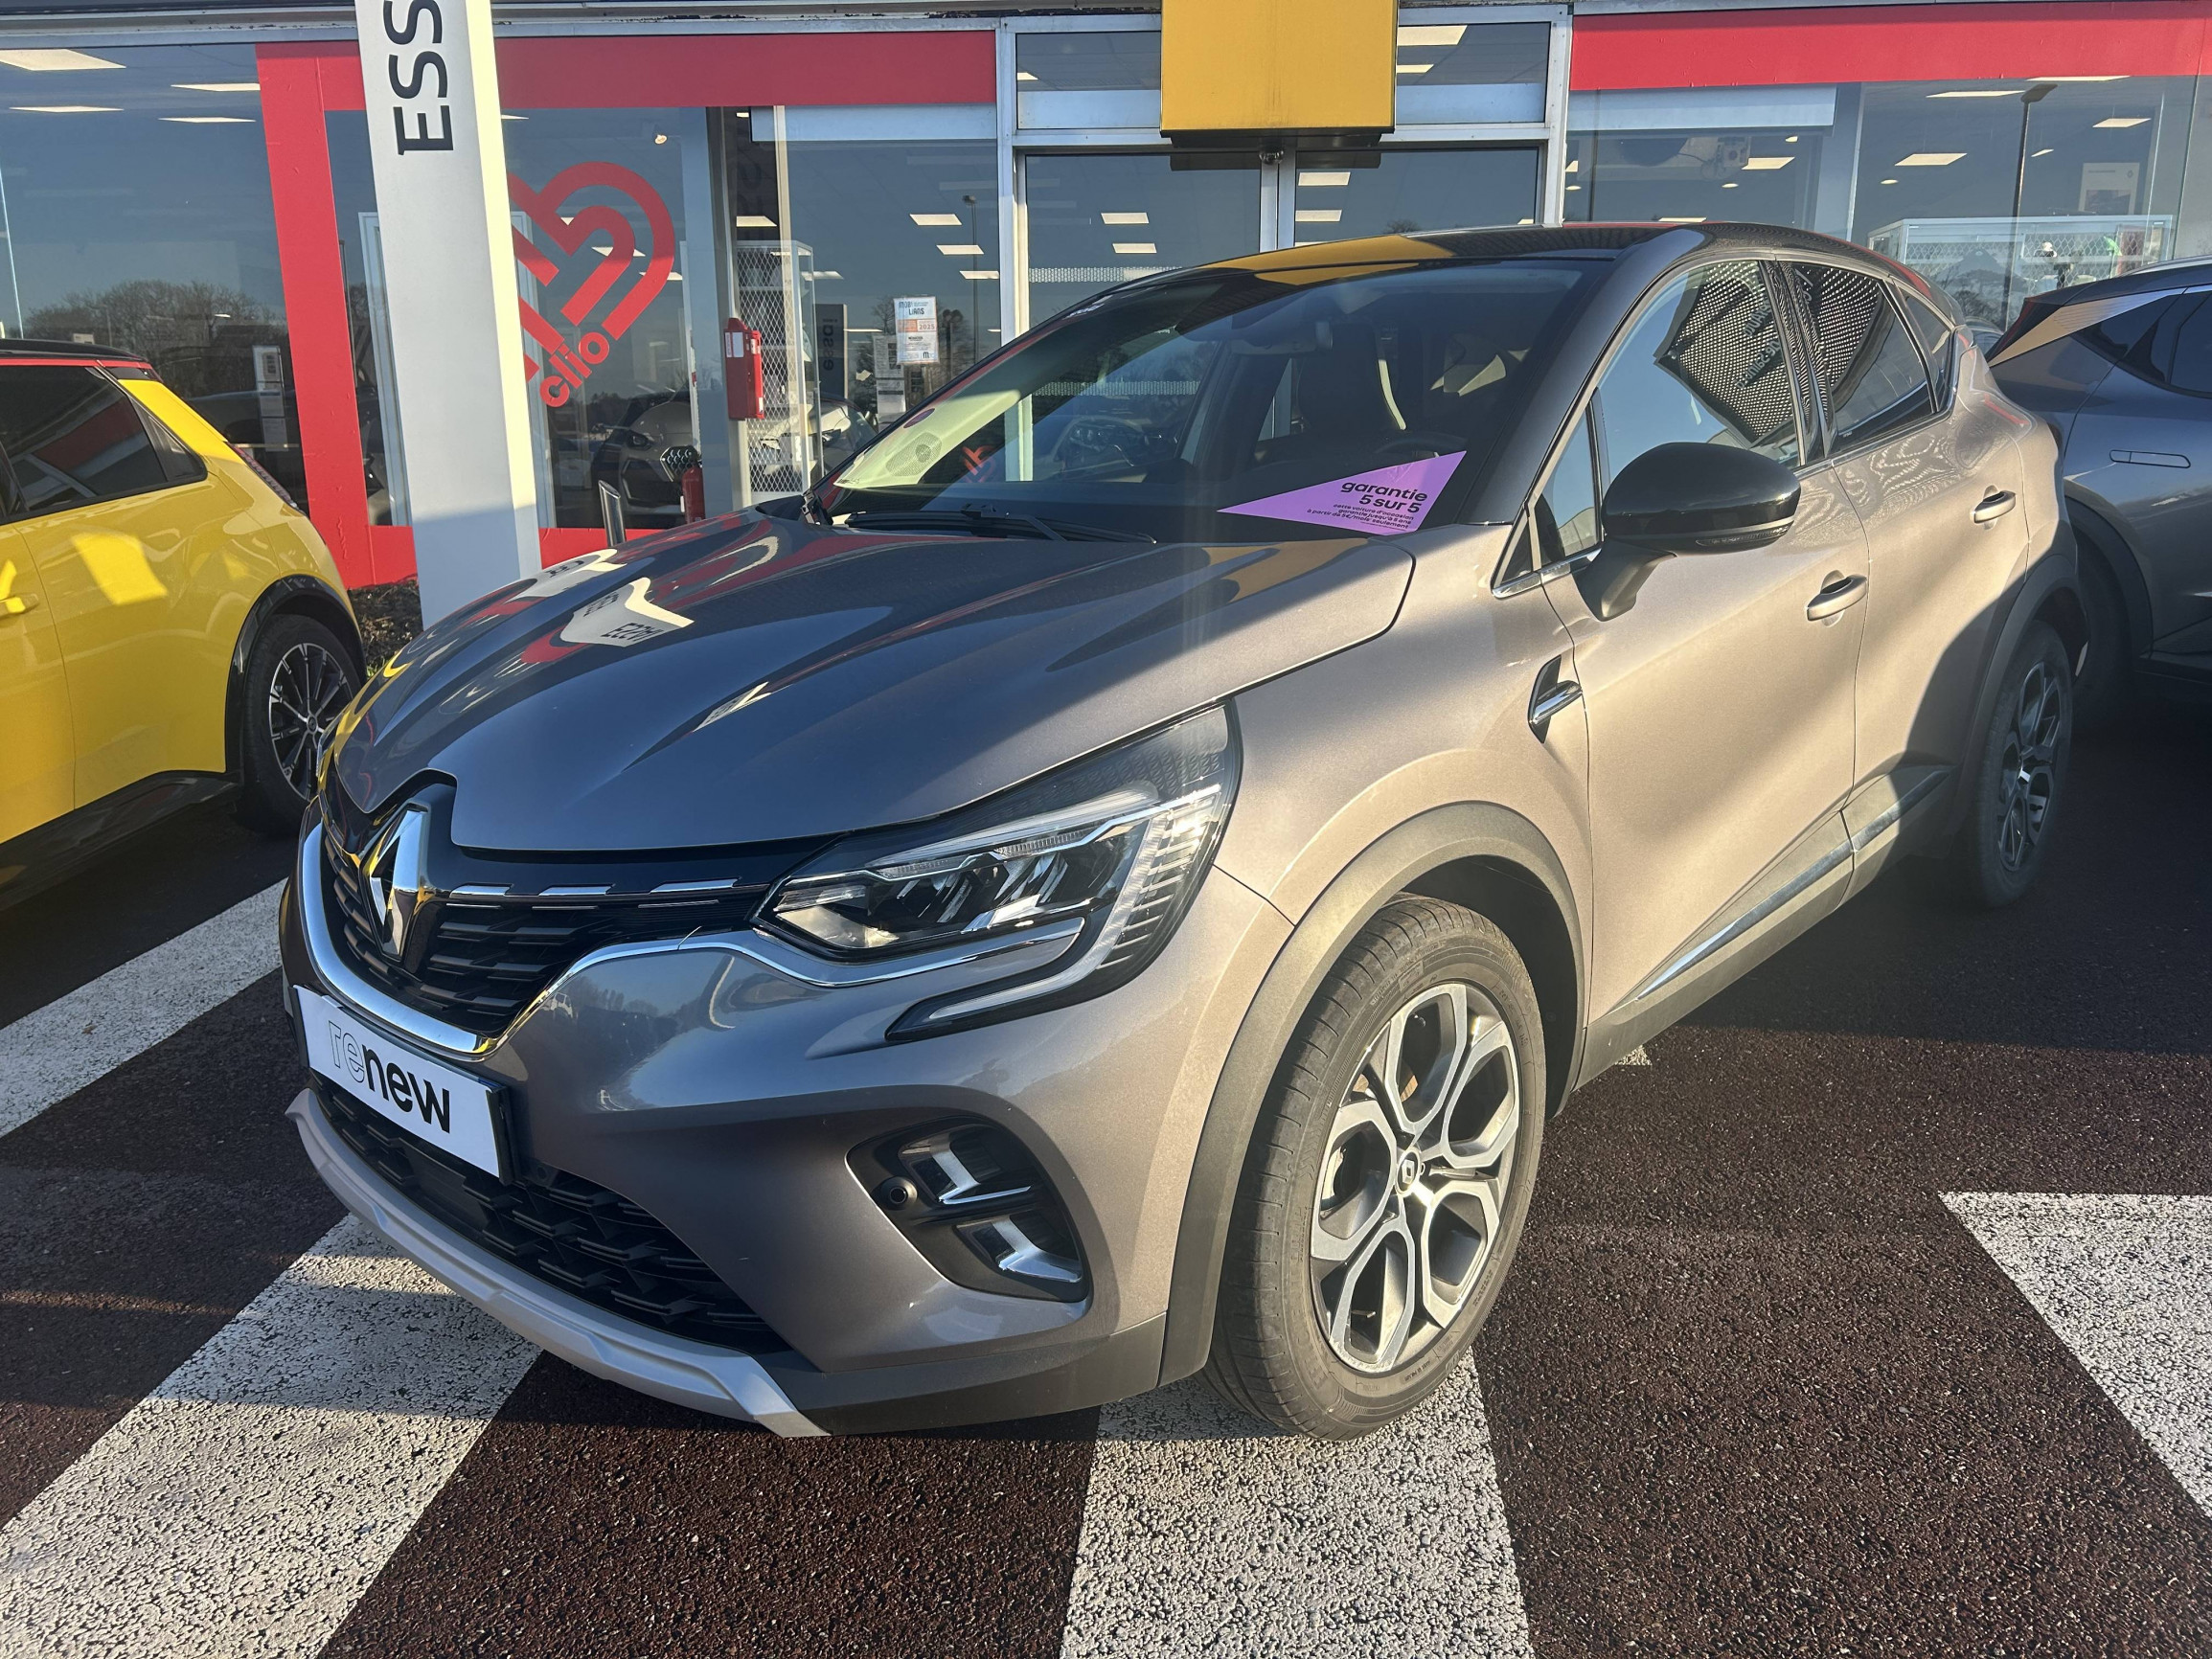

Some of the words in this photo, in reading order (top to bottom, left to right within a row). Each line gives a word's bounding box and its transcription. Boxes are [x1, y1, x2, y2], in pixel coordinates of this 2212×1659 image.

[383, 0, 454, 156] ESS
[539, 331, 610, 408] clio
[1340, 482, 1428, 502] garantie
[1358, 494, 1374, 505] 5
[1373, 498, 1407, 511] sur
[1407, 502, 1423, 513] 5
[1338, 509, 1368, 517] garantie
[1366, 513, 1393, 522] jusqu'à
[1372, 518, 1409, 529] seulement
[1376, 510, 1414, 521] d'occasion
[328, 1019, 450, 1135] renew
